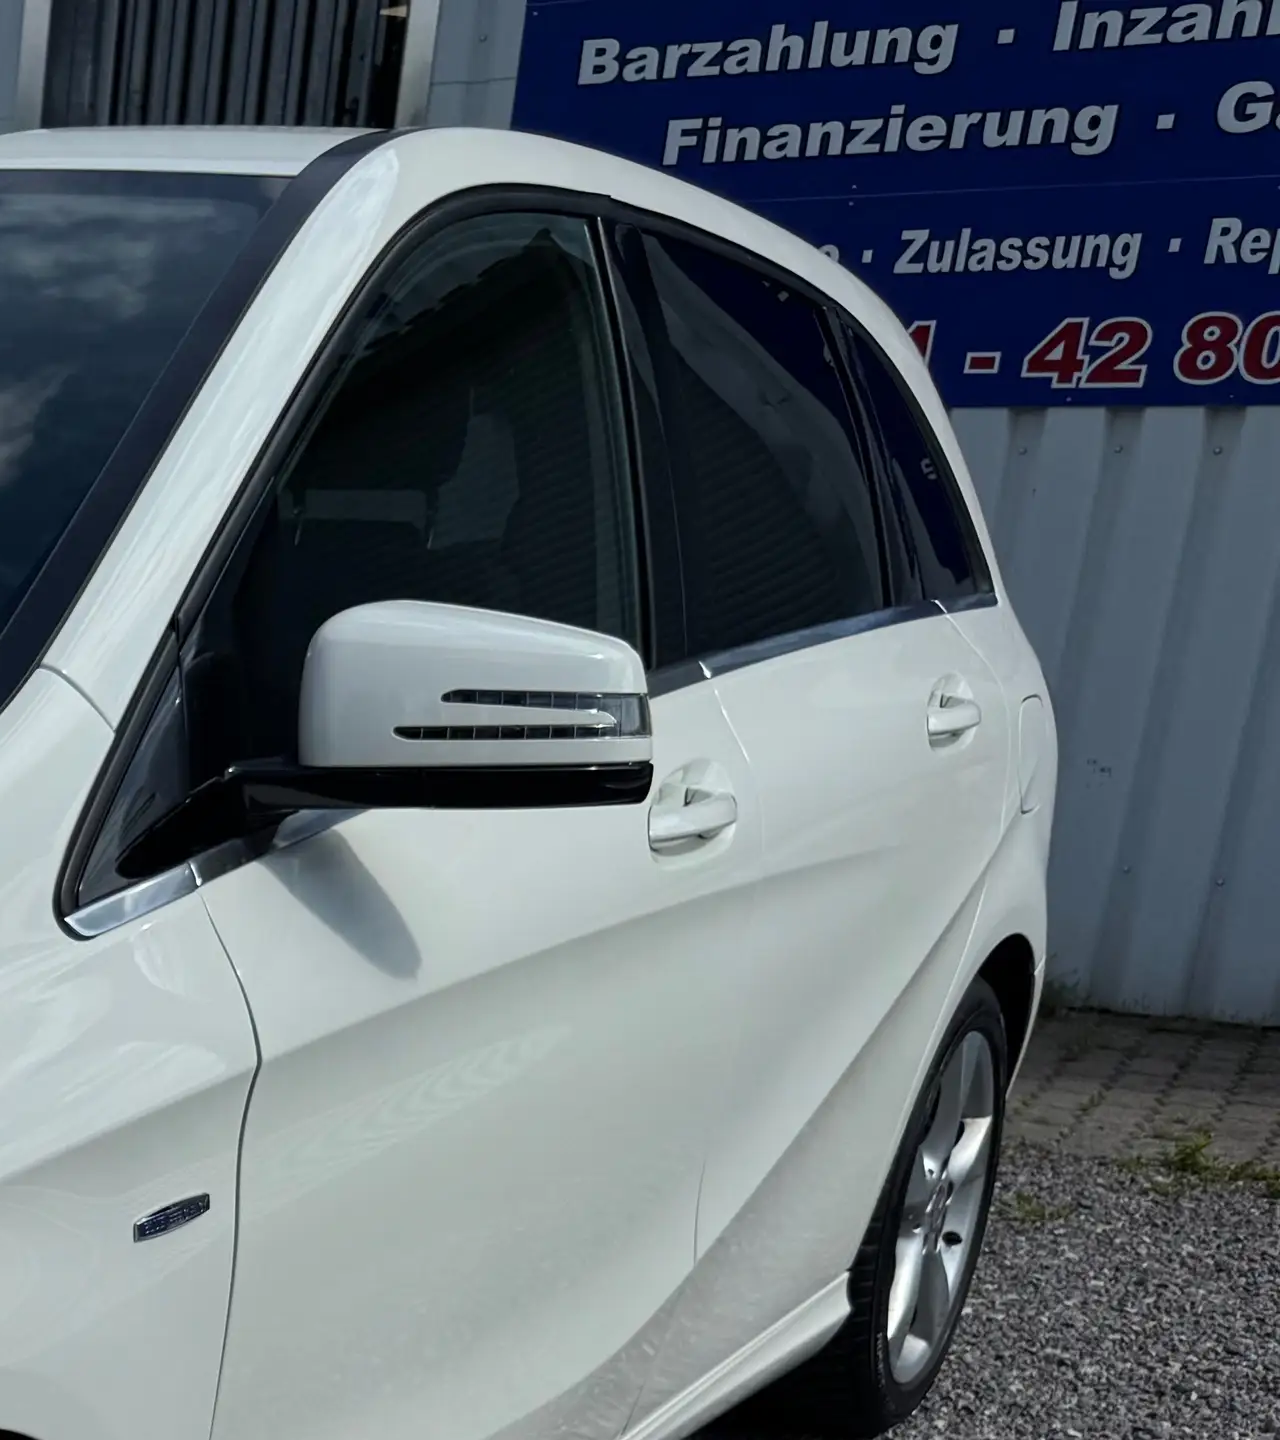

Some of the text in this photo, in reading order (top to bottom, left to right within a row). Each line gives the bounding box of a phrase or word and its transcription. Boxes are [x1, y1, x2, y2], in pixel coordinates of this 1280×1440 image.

[577, 20, 959, 86] Barzahlung
[662, 80, 1280, 166] Finanzierung G
[893, 228, 1142, 280] Zulassung
[1020, 316, 1153, 389] 42
